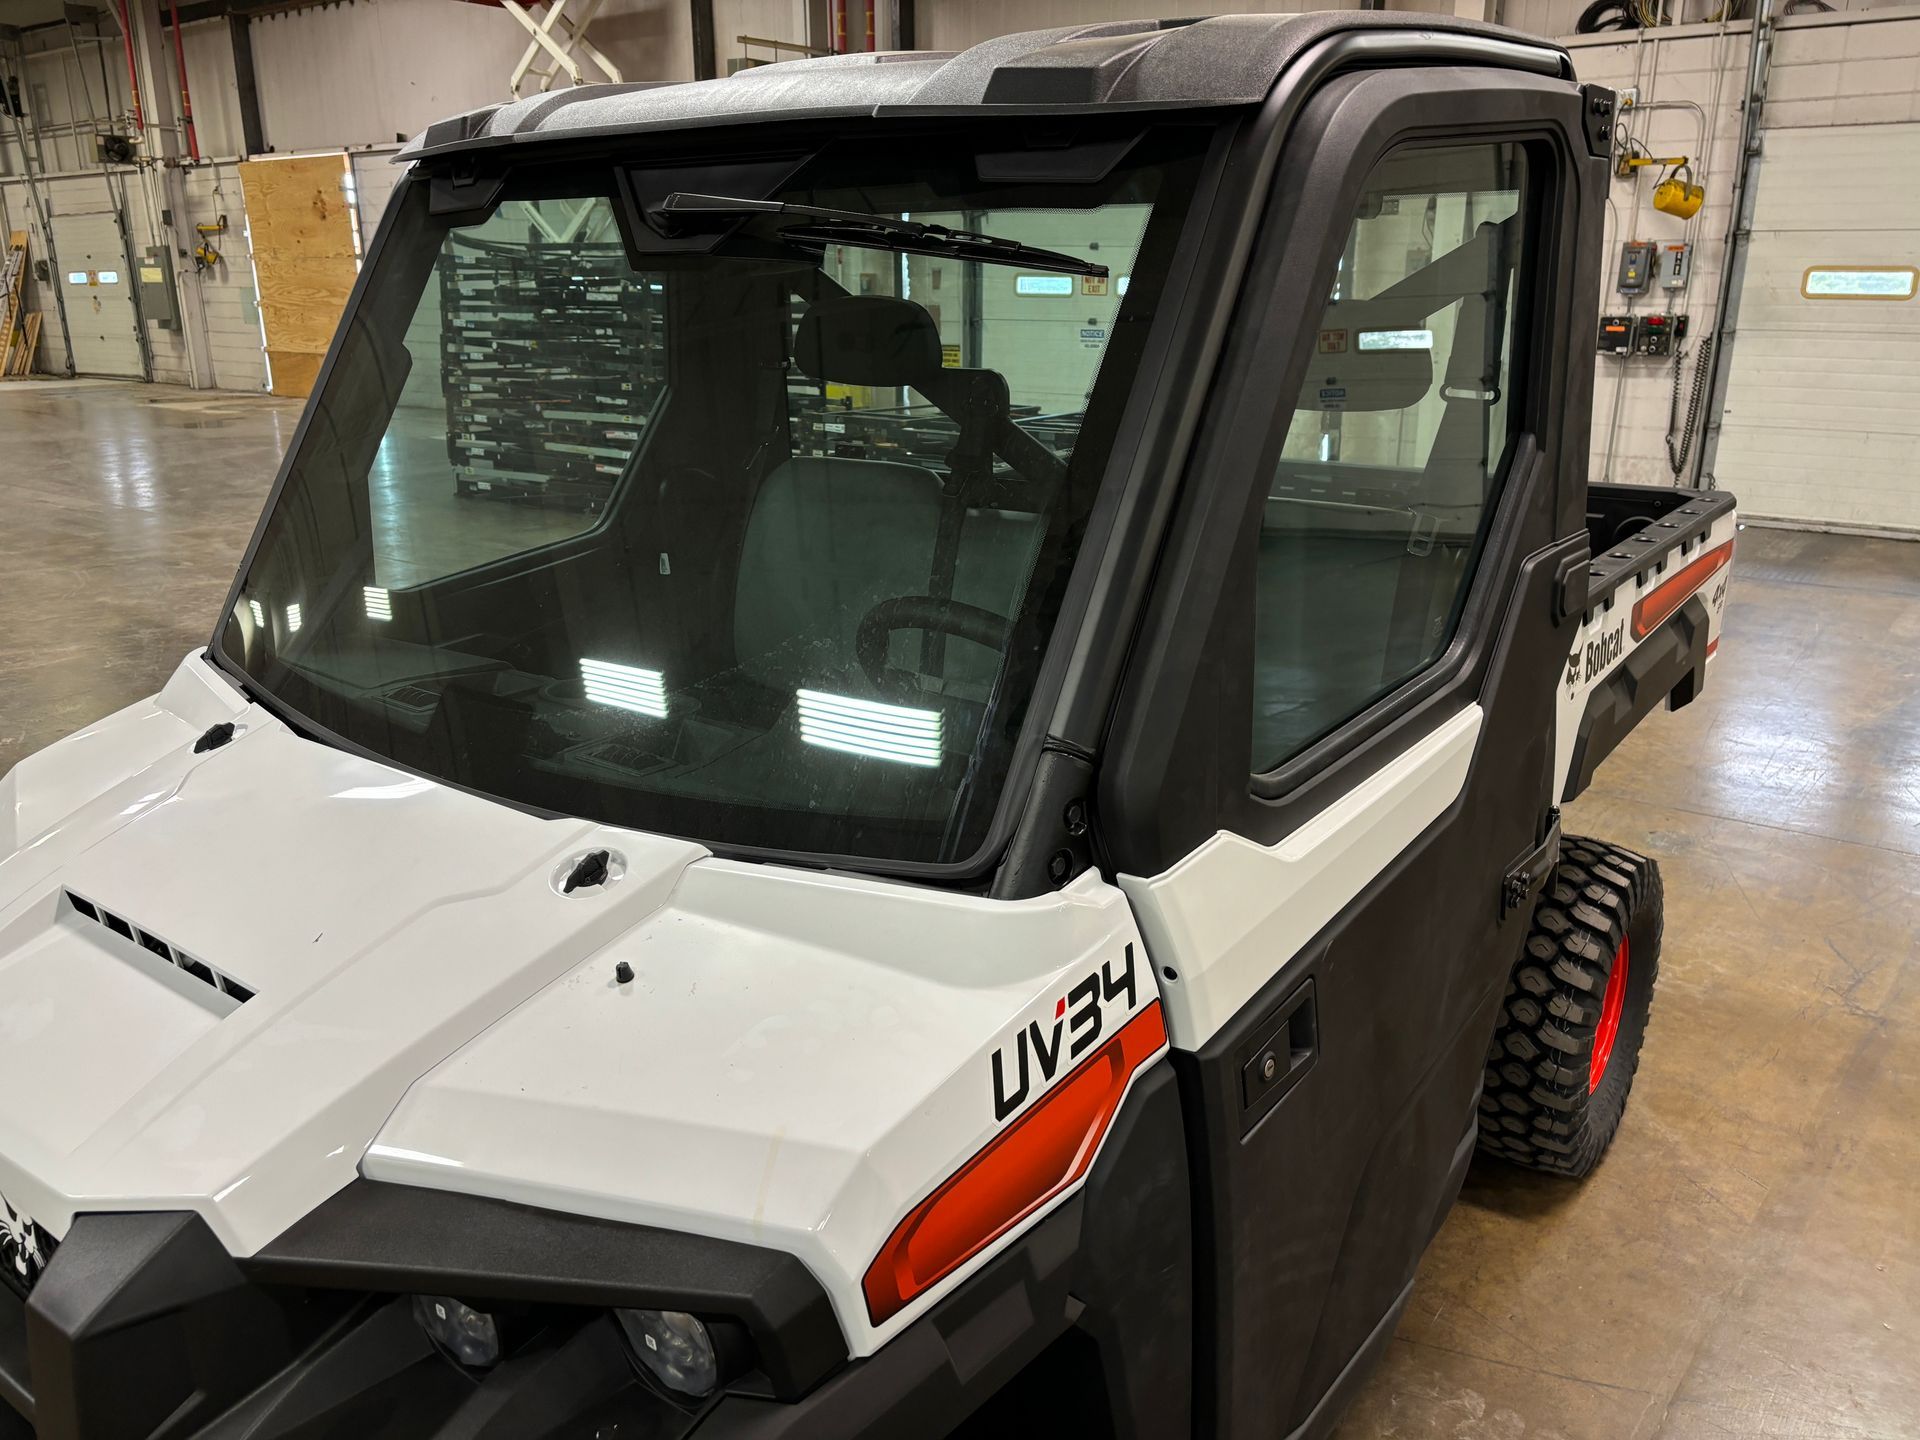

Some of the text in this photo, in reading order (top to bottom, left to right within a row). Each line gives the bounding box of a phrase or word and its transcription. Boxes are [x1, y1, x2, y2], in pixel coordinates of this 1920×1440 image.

[1088, 285, 1100, 293] EXIT
[1081, 330, 1104, 338] NOTICE
[1584, 618, 1625, 684] Bobcat
[991, 941, 1137, 1122] UV34
